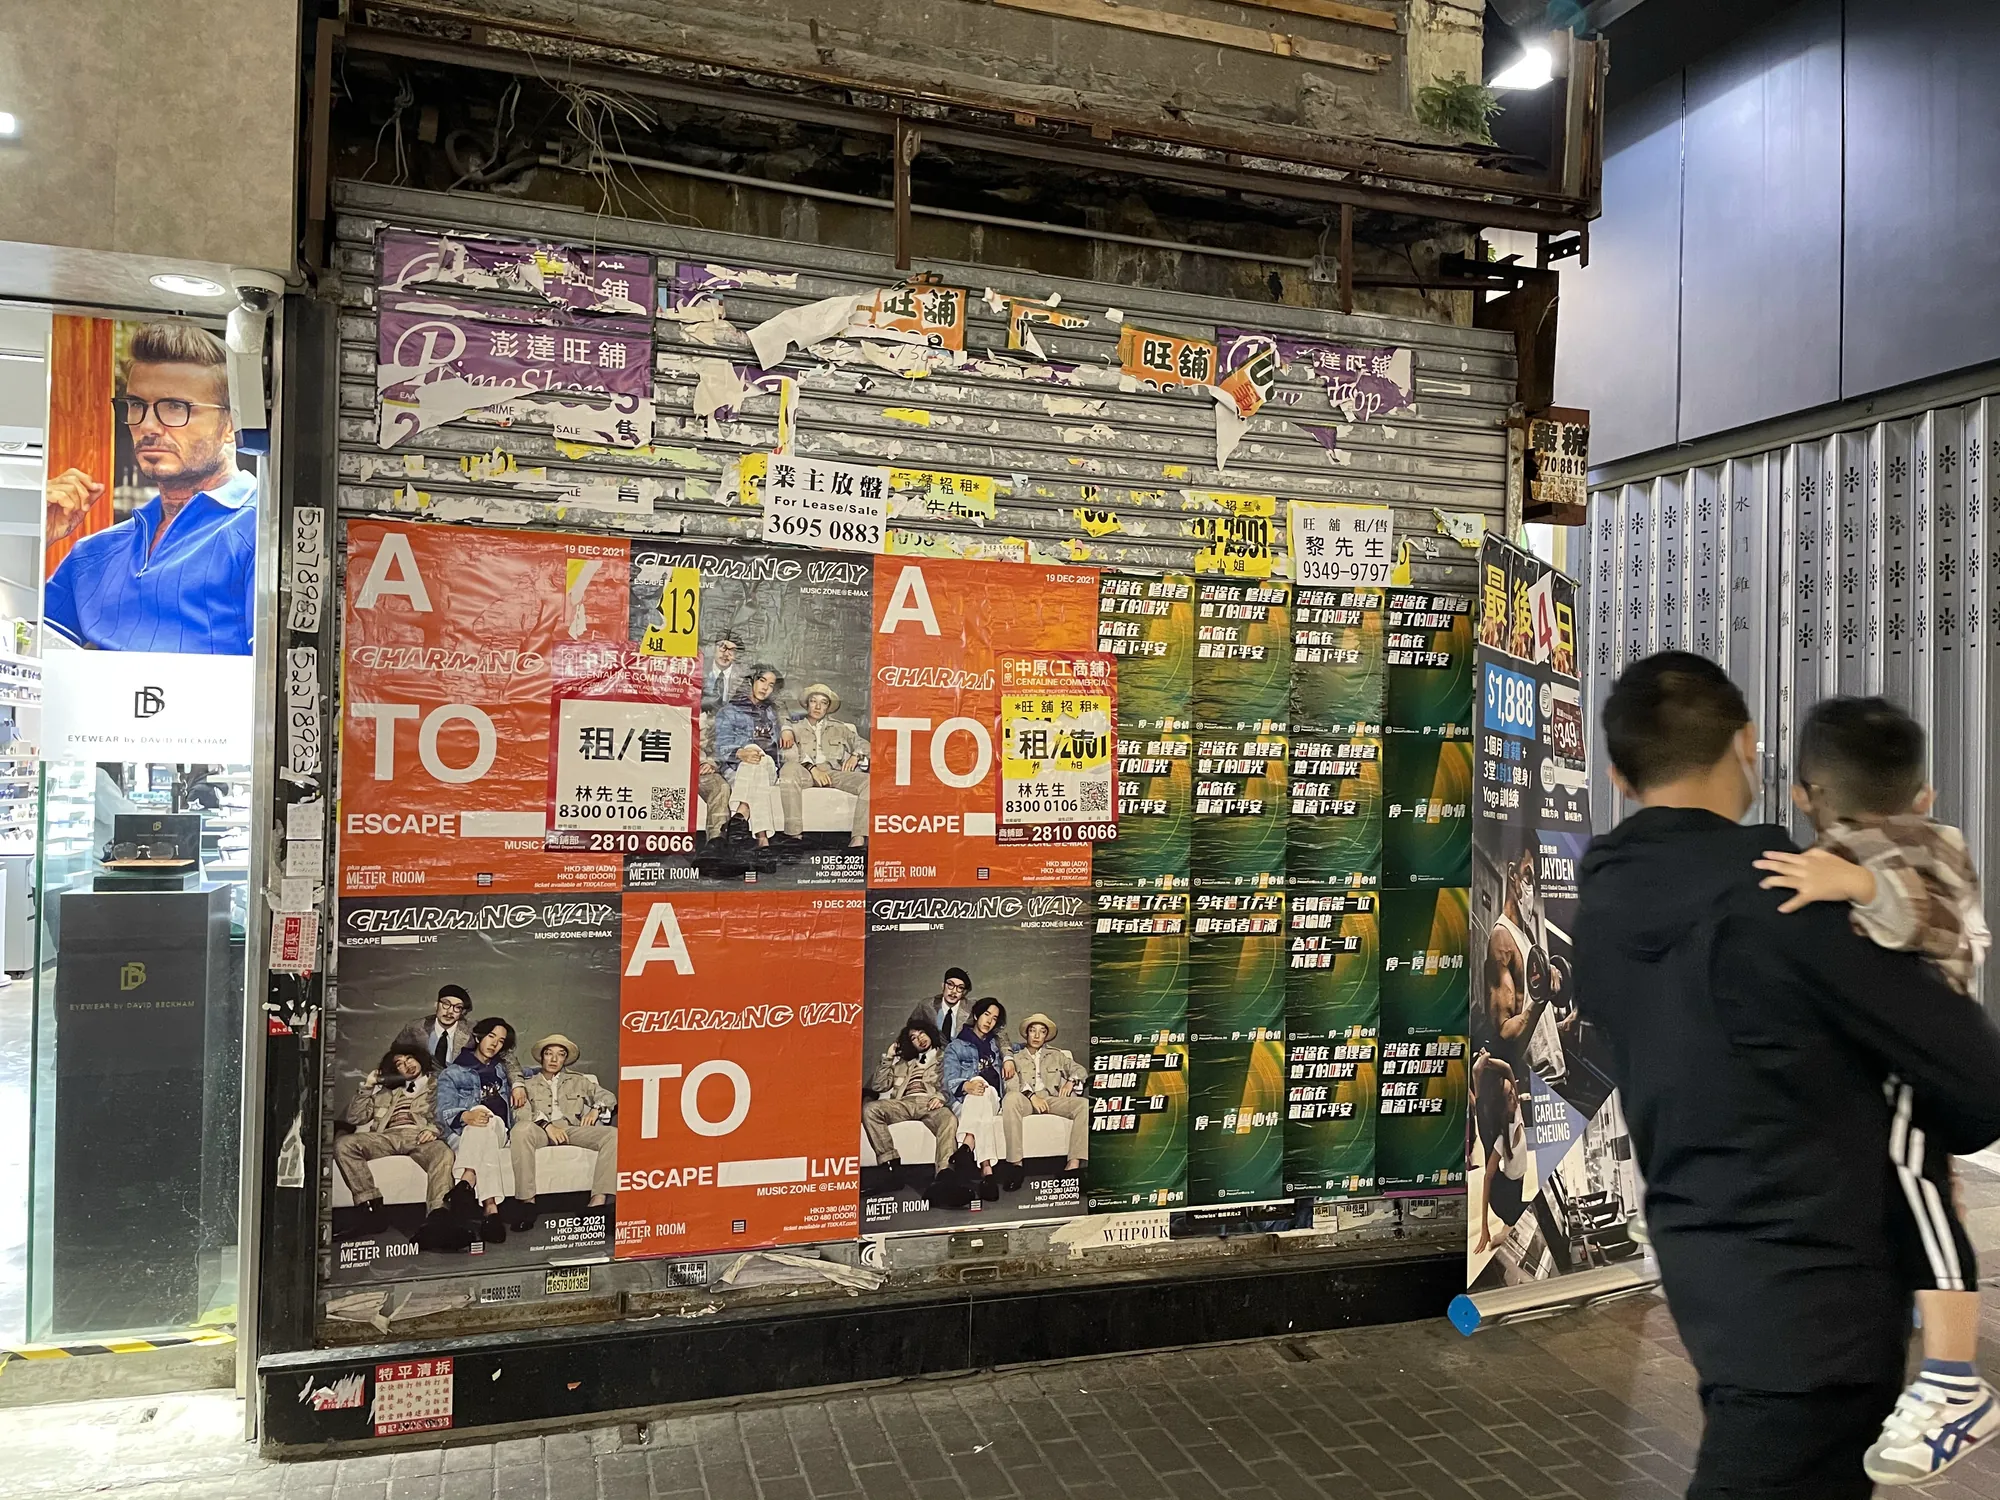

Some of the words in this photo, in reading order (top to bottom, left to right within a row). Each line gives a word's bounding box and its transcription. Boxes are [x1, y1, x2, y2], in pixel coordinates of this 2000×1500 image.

[490, 331, 627, 369] 澎達旺舖
[1143, 339, 1212, 382] 旺舖
[556, 426, 581, 436] SALE
[772, 464, 882, 500] 業主放盤
[774, 496, 797, 508] For
[803, 499, 878, 517] Lease/Sale
[768, 514, 822, 538] 3695
[828, 519, 880, 545] 0883
[564, 545, 576, 554] 19
[578, 546, 600, 555] DEC
[602, 547, 625, 556] 2021
[1305, 538, 1385, 559] 黎先生
[355, 533, 433, 612] A
[808, 561, 869, 585] WAY
[1046, 573, 1055, 582] 19
[1057, 574, 1075, 583] DEC
[1077, 575, 1095, 584] 2021
[1303, 560, 1389, 582] 9349-9797
[879, 565, 942, 636] A
[352, 646, 545, 674] CHARMING
[1016, 678, 1059, 687] CENTALINE
[1060, 678, 1111, 687] COMMERCIAL
[1489, 670, 1533, 728] $1,888
[68, 734, 119, 744] EYEWEAR
[351, 703, 497, 784] TO
[579, 727, 672, 763] 租/售
[1555, 722, 1577, 748] $349
[877, 717, 993, 788] TO
[575, 785, 633, 803] 林先生
[1018, 782, 1065, 798] 林先生
[559, 804, 601, 818] 8300
[606, 805, 647, 819] 0106
[1006, 800, 1040, 813] 8300
[1044, 800, 1078, 812] 0106
[347, 814, 455, 835] ESCAPE
[874, 815, 960, 833] ESCAPE
[1032, 826, 1072, 841] 2810
[1077, 824, 1117, 840] 6066
[590, 834, 639, 851] 2810
[645, 836, 693, 852] 6066
[810, 856, 821, 864] 19
[823, 856, 842, 865] DEC
[844, 855, 864, 864] 2021
[1540, 857, 1574, 881] JAYDEN
[347, 871, 386, 885] METER
[392, 871, 425, 884] ROOM
[629, 868, 665, 881] METER
[670, 867, 699, 880] ROOM
[874, 866, 905, 877] METER
[910, 866, 936, 877] ROOM
[825, 900, 844, 908] DEC
[846, 899, 866, 908] 2021
[872, 896, 1022, 920] CHARMING
[1028, 895, 1083, 917] WAY
[347, 904, 537, 932] CHARMING
[543, 903, 612, 928] WAY
[347, 937, 380, 945] ESCAPE
[420, 935, 437, 943] LIVE
[535, 932, 559, 940] MUSIC
[624, 903, 695, 976] A
[70, 1003, 110, 1012] EYEWEAR
[127, 1002, 152, 1010] DAVID
[155, 1000, 195, 1009] BECKHAM
[622, 1004, 794, 1032] CHARMING
[800, 1002, 863, 1027] WAY
[621, 1059, 751, 1139] TO
[1535, 1102, 1565, 1122] CARLEE
[1536, 1123, 1571, 1144] CHEUNG
[617, 1166, 713, 1191] ESCAPE
[811, 1156, 859, 1178] LIVE
[757, 1186, 788, 1196] MUSIC
[790, 1184, 816, 1194] ZONE
[819, 1181, 858, 1192] @E-MAX
[832, 1211, 857, 1220] (DOOR)
[838, 1204, 857, 1213] (ADV)
[866, 1203, 898, 1216] METER
[902, 1200, 929, 1213] ROOM
[544, 1219, 556, 1229] 19
[558, 1217, 580, 1228] DEC
[583, 1215, 605, 1226] 2021
[616, 1225, 651, 1239] METER
[656, 1222, 686, 1237] ROOM
[340, 1246, 380, 1263] METER
[386, 1241, 419, 1257] ROOM
[379, 1361, 450, 1381] 特平清拆
